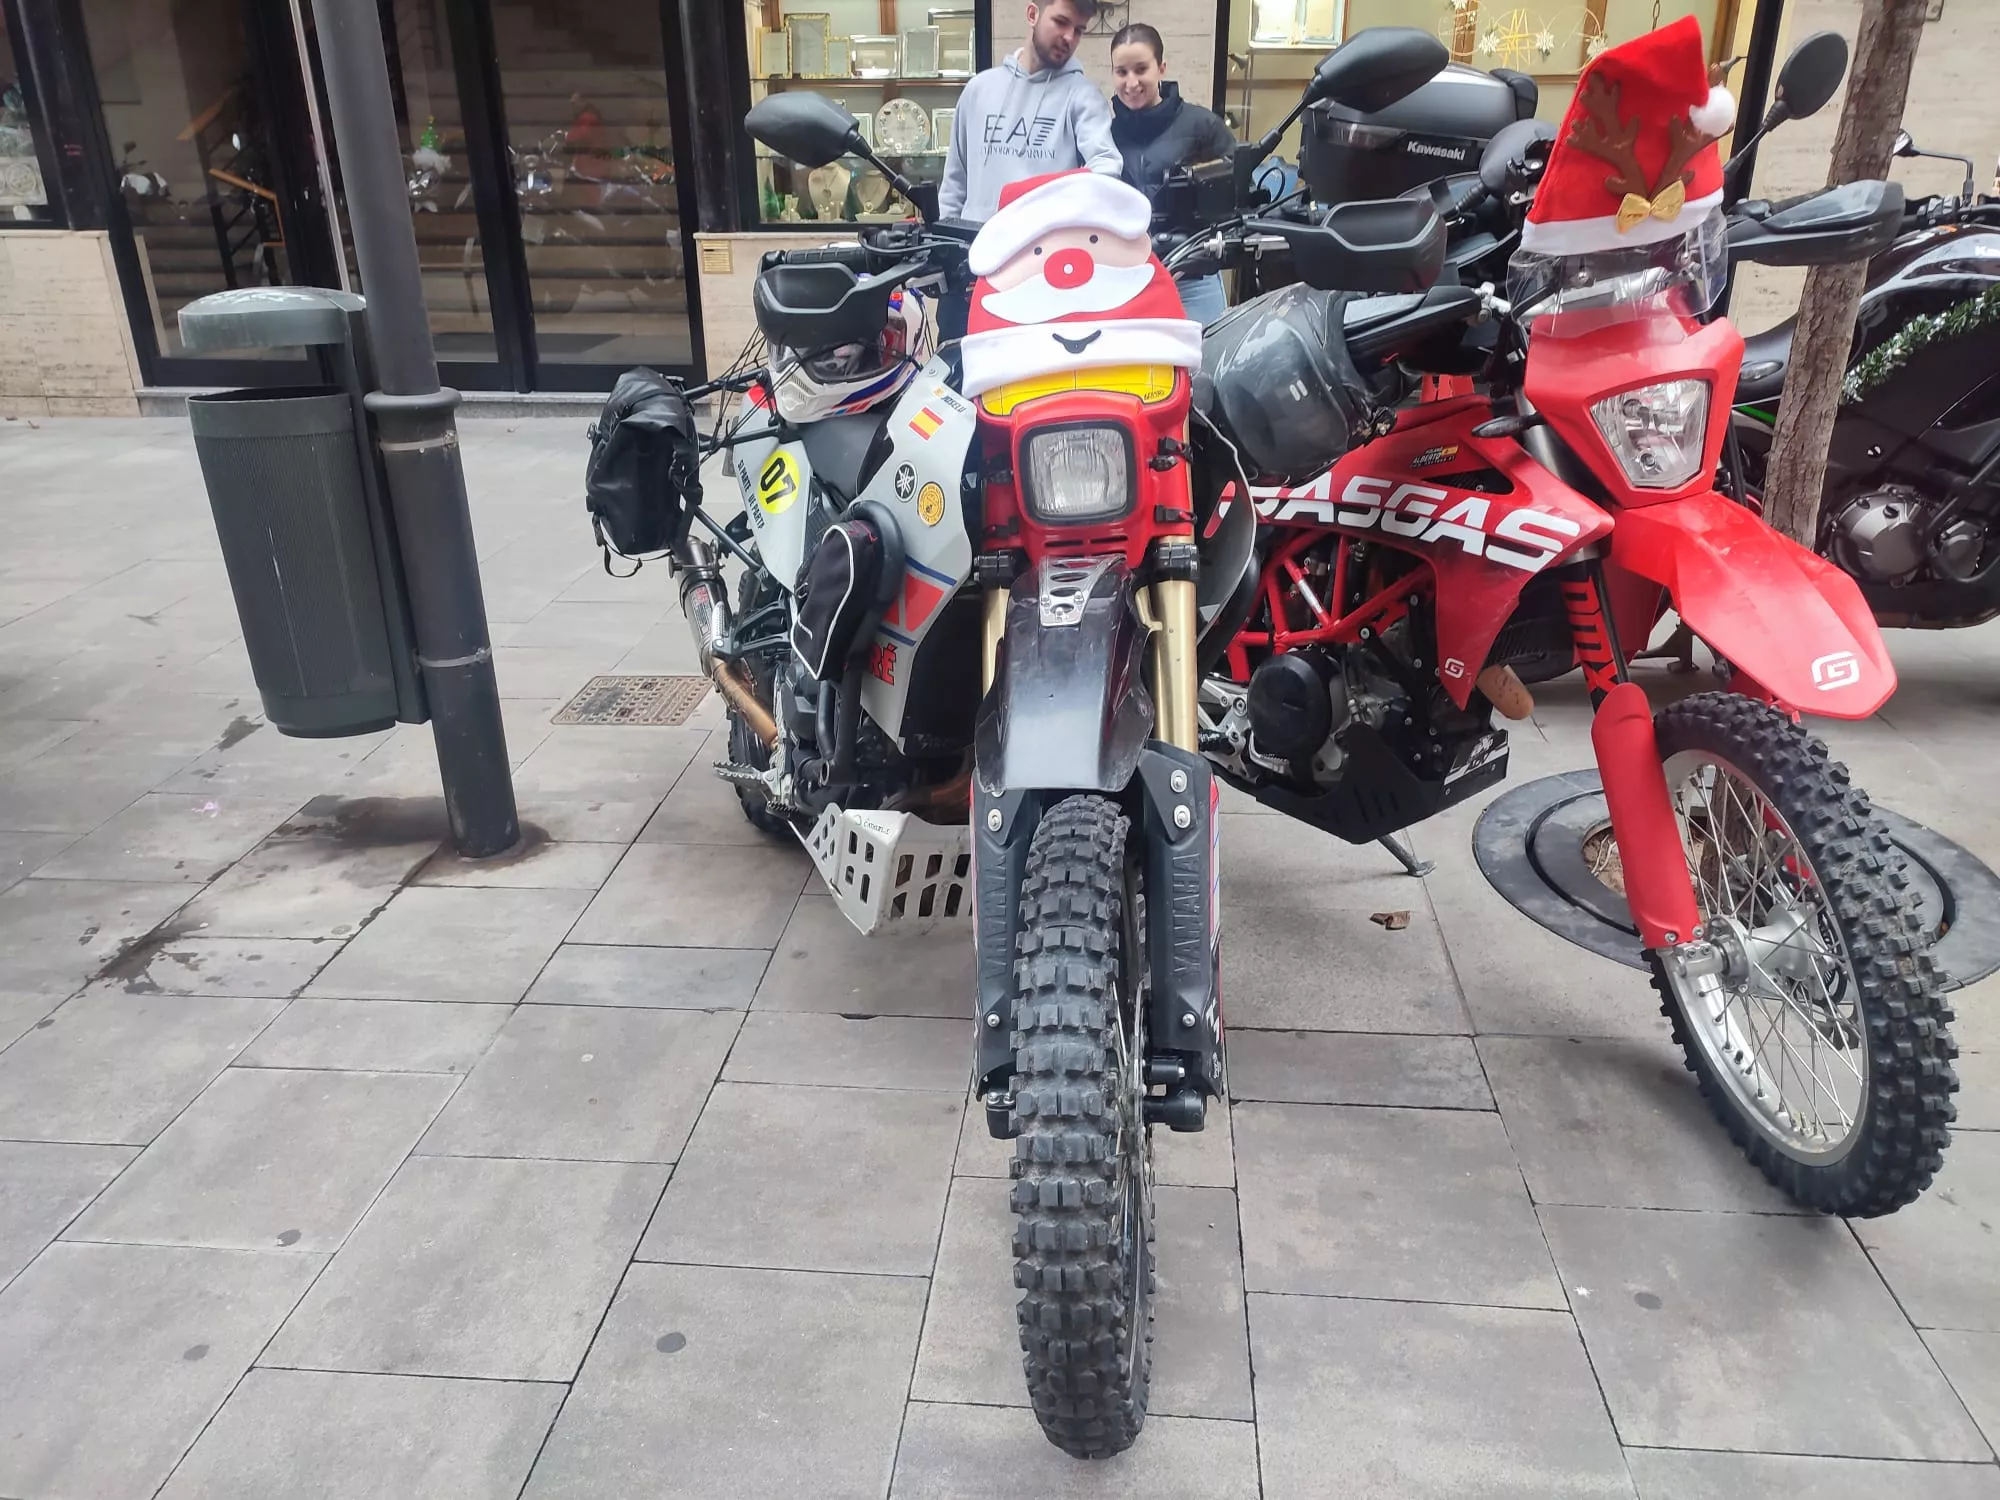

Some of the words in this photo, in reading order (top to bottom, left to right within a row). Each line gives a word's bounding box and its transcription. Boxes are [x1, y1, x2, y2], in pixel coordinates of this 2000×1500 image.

[1407, 140, 1466, 161] Kawasaki
[760, 457, 796, 505] 07
[985, 853, 1007, 980] YAMAHA
[1172, 852, 1201, 973] YAMAHA
